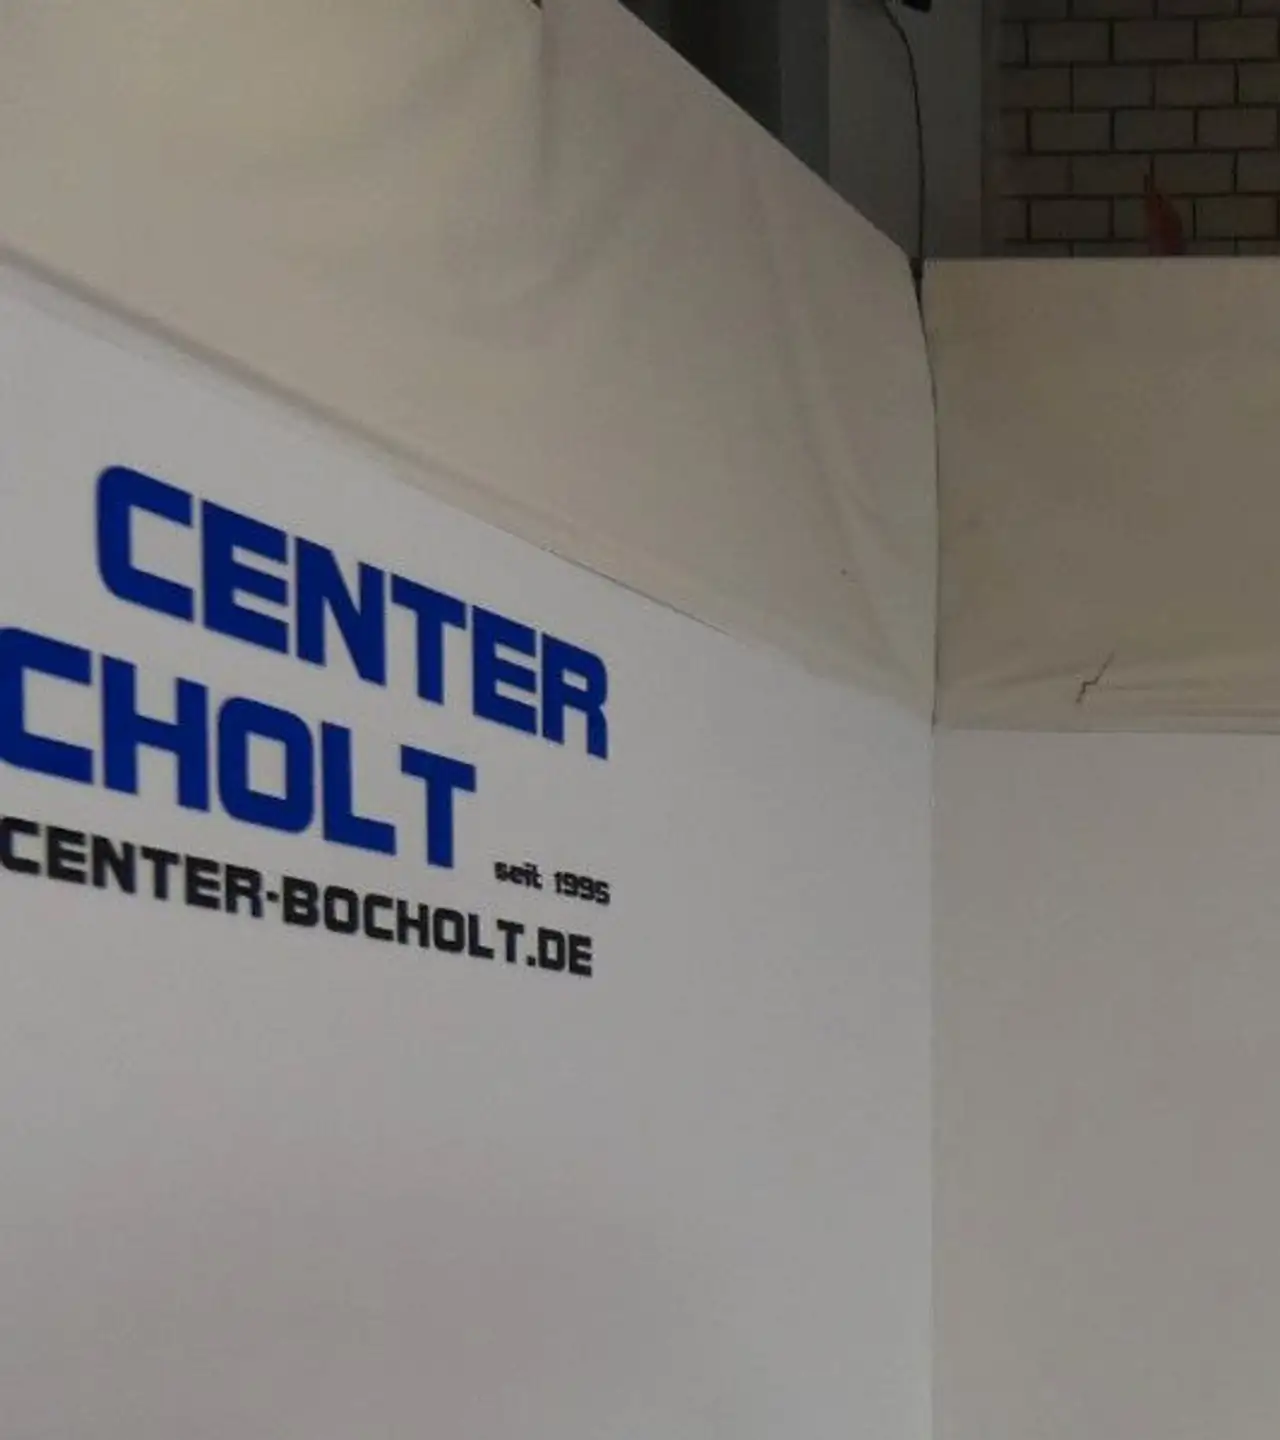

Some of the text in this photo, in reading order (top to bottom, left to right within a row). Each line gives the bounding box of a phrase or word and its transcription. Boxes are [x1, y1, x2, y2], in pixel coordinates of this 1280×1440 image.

[95, 465, 608, 761] CENTER
[0, 626, 612, 906] CHOLT seit 1995
